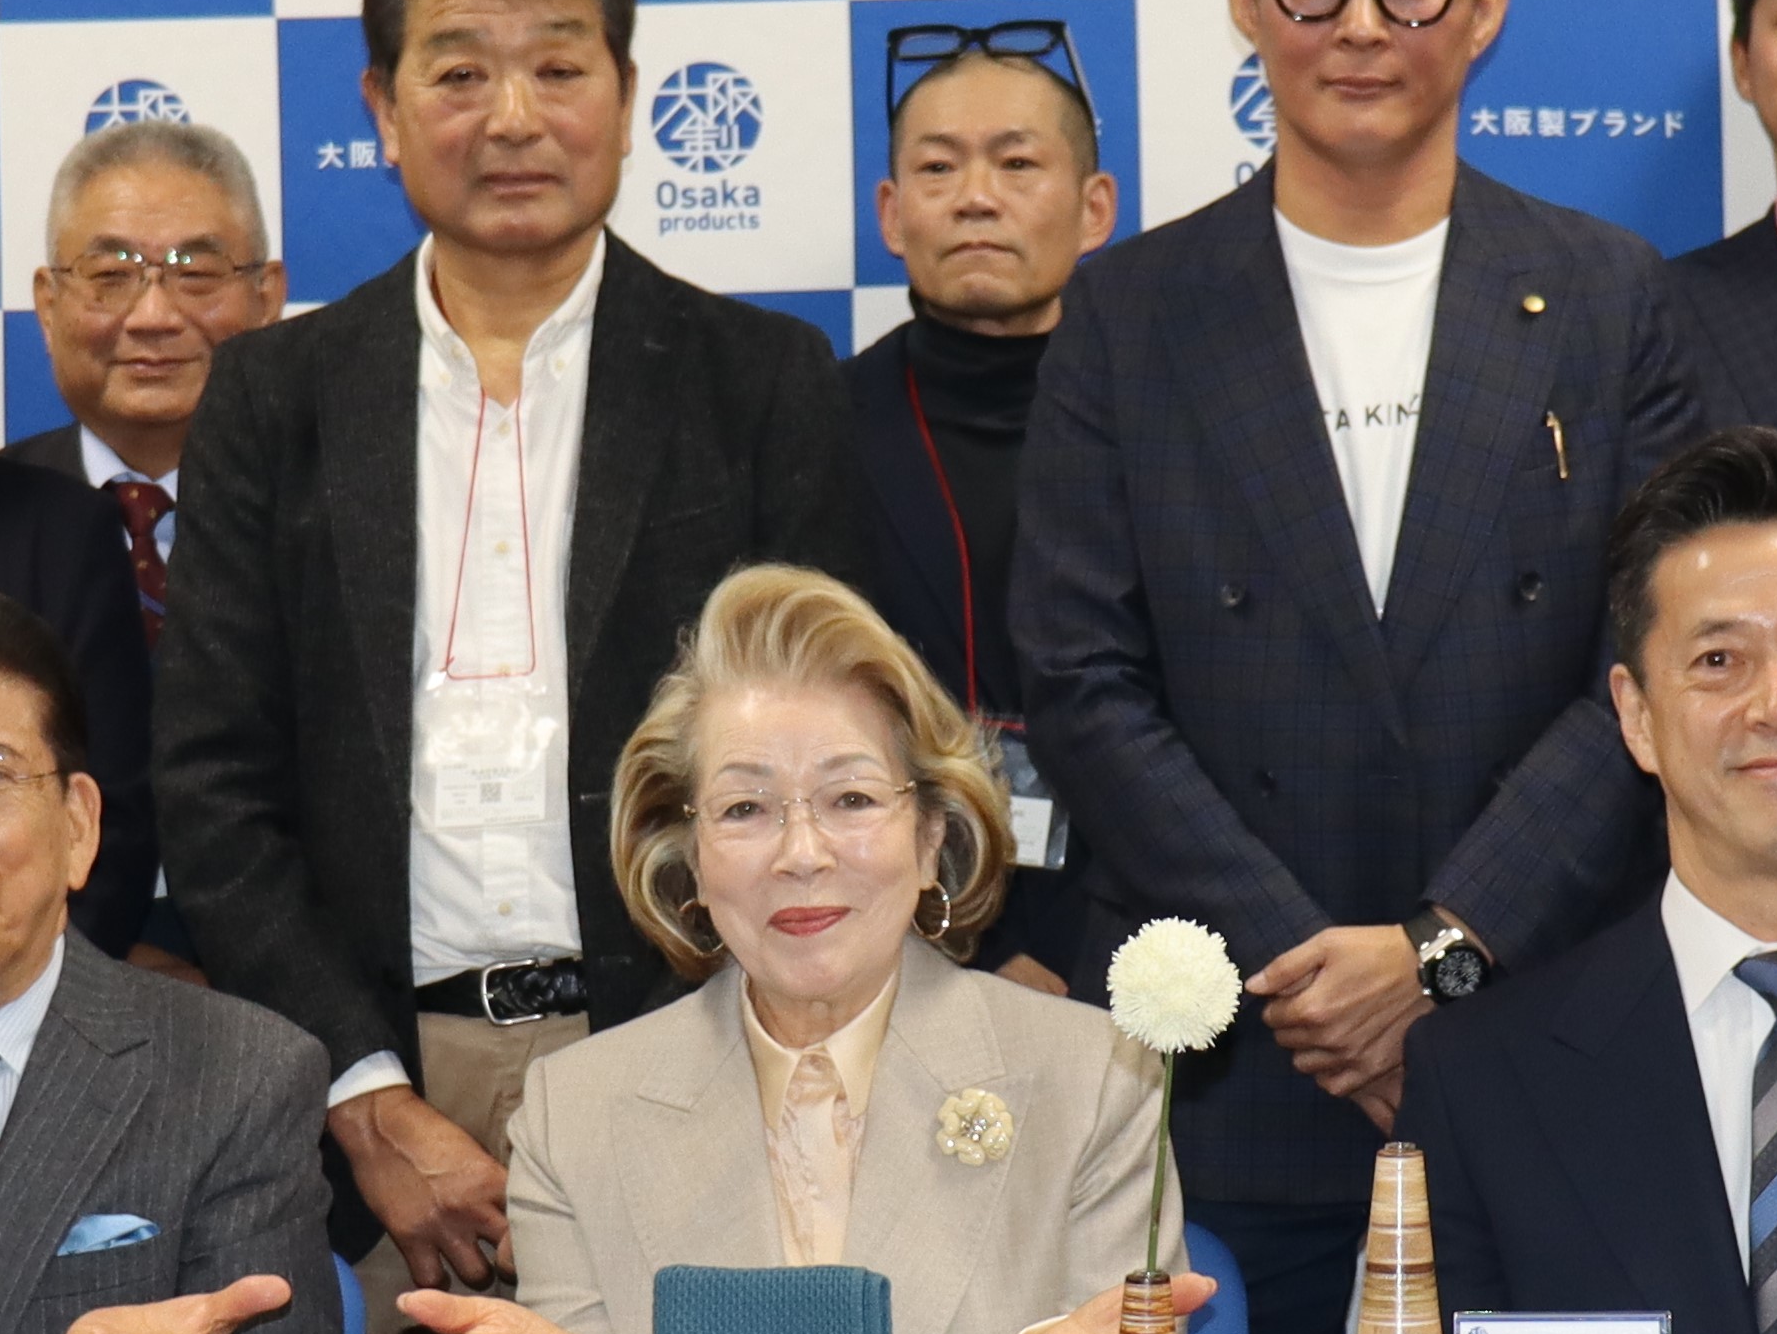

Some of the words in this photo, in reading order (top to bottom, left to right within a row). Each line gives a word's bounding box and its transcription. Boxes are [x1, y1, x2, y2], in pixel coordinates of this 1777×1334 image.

[1471, 106, 1686, 139] 大阪製ブランド
[656, 179, 760, 208] Osaka
[659, 211, 760, 233] products
